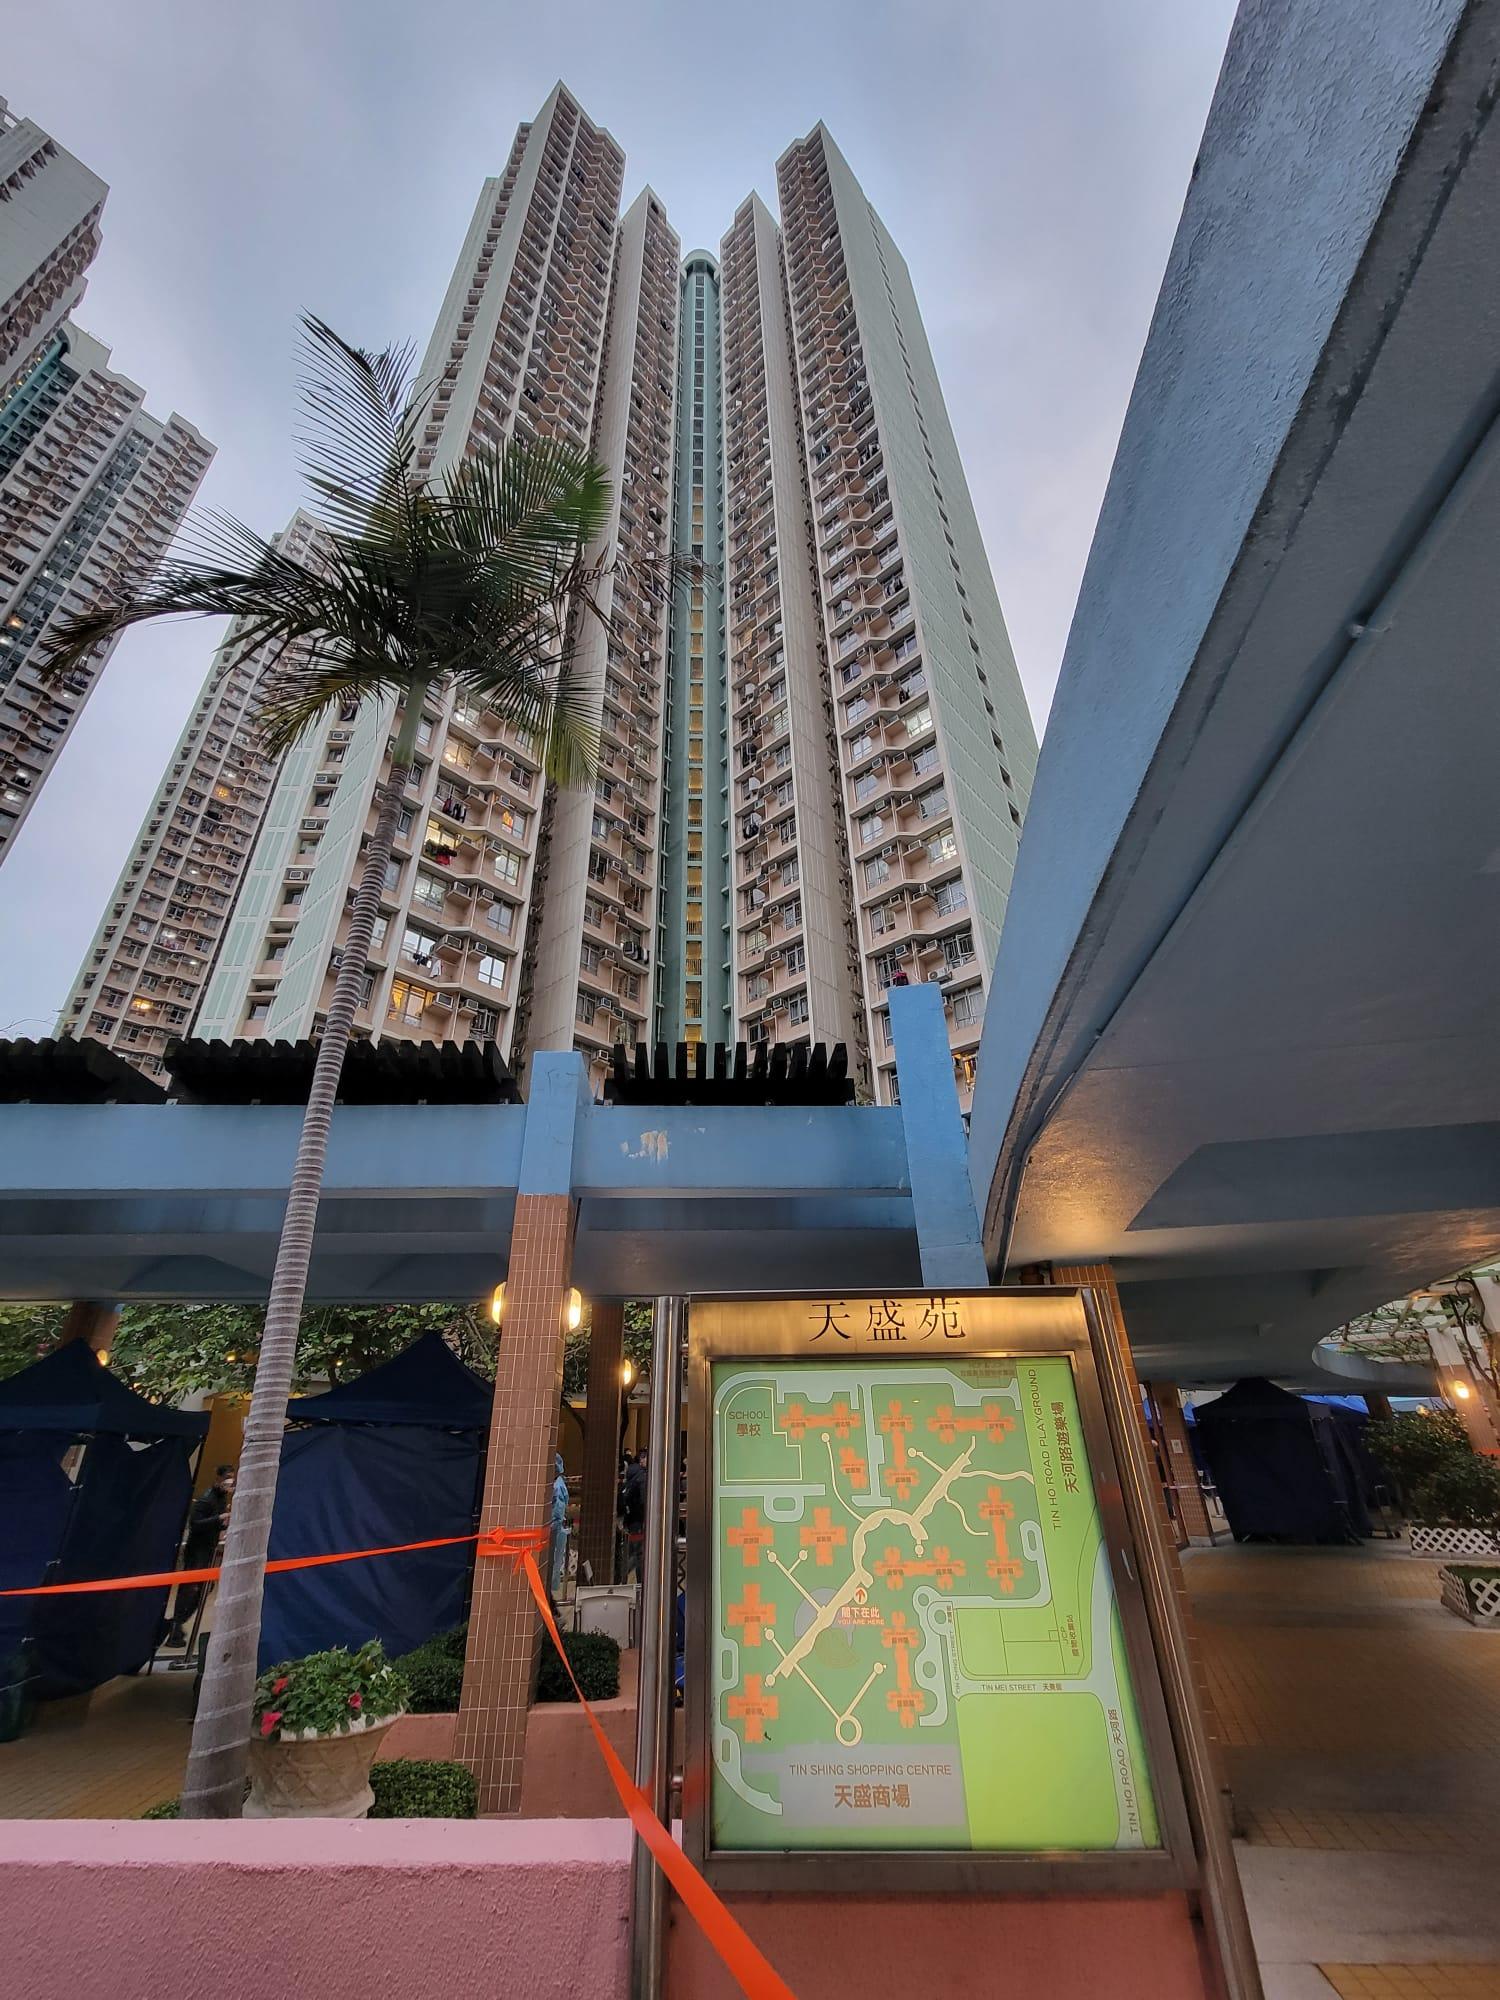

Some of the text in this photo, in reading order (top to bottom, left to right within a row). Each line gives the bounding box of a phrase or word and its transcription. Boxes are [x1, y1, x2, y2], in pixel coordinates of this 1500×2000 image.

[808, 1297, 966, 1342] 天盛苑
[728, 1410, 770, 1420] SCHOOL
[736, 1423, 761, 1437] 學校
[1028, 1369, 1062, 1531] TIN HO ROAD PLAYGROUND
[1051, 1401, 1080, 1494] 天河路遊樂場
[1108, 1708, 1124, 1744] 天河路
[789, 1763, 952, 1776] TIN SHING SHOPPING CENTRE
[834, 1783, 911, 1809] 天盛商場
[1117, 1749, 1139, 1835] TIN HO ROAD
